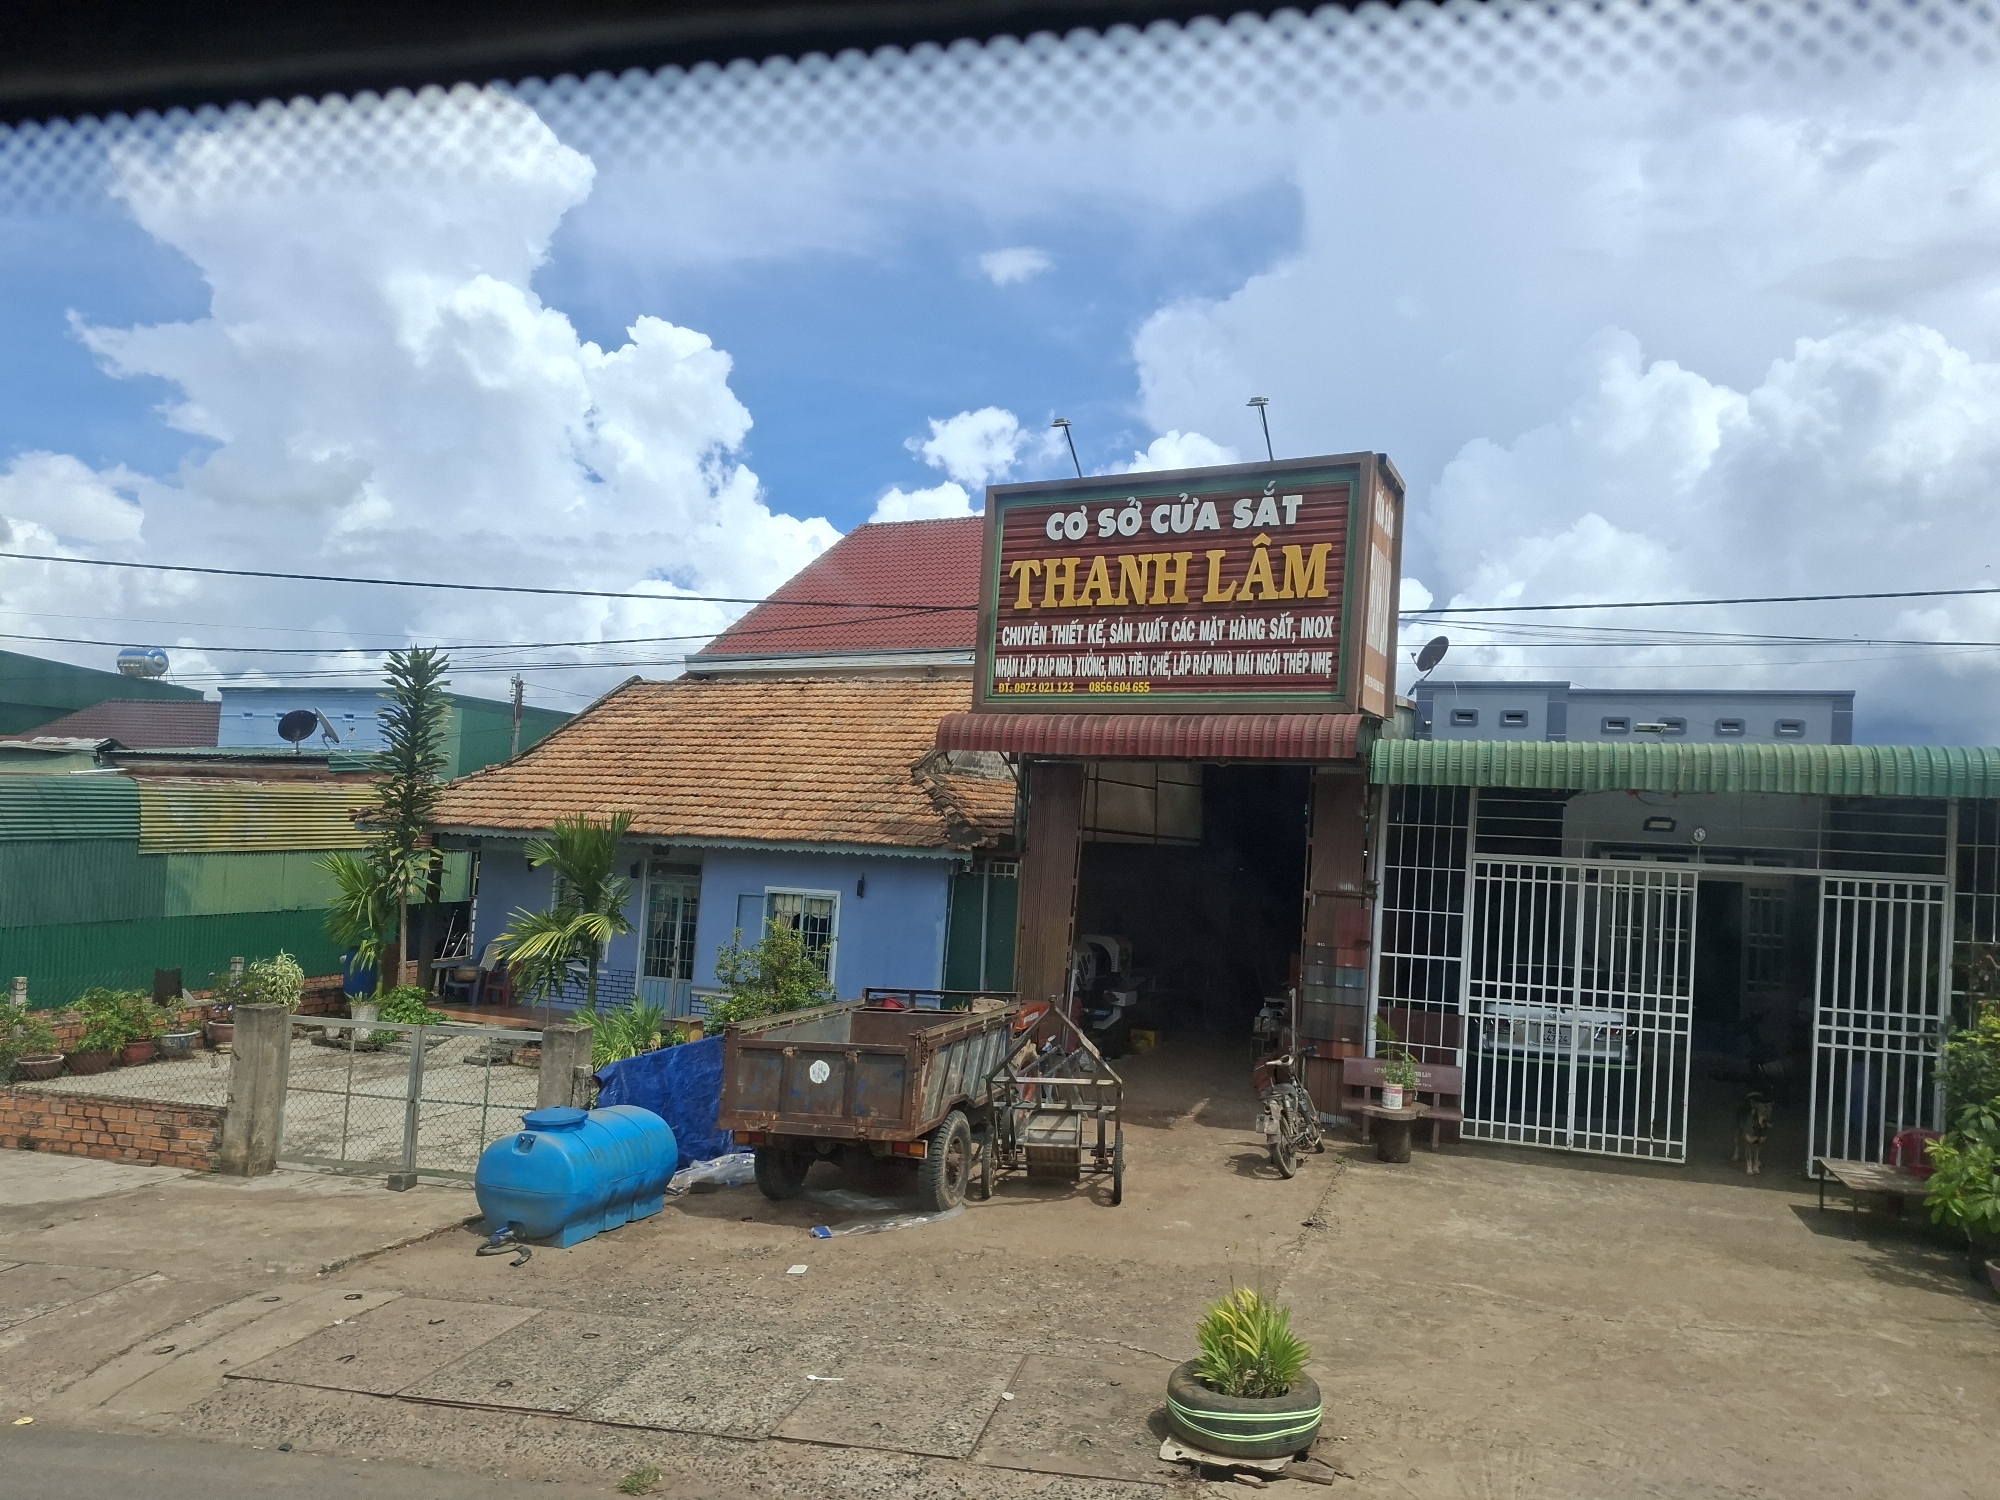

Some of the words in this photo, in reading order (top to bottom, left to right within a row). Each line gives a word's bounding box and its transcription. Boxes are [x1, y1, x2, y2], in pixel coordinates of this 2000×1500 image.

[1046, 505, 1089, 541] CƠ
[1097, 497, 1143, 538] SỞ
[1150, 492, 1221, 534] CỬA
[1232, 480, 1303, 529] SẮT
[1009, 551, 1193, 610] THANH
[1202, 532, 1333, 603] LÂM
[1001, 621, 1047, 647] CHUYÊN
[1051, 618, 1085, 645] THIẾT
[1087, 617, 1107, 648] KẾ,
[1109, 616, 1133, 644] SẢN
[1136, 615, 1169, 643] XUẤT
[1171, 616, 1196, 642] CÁC
[1199, 615, 1226, 646] MẶT
[1229, 614, 1266, 641] HÀNG
[1269, 611, 1296, 644] SẮT,
[1300, 615, 1335, 639] INOX
[995, 654, 1019, 682] NHẬN
[1020, 653, 1037, 678] LẮP
[1037, 654, 1056, 677] RÁP
[1055, 653, 1073, 677] NHÀ
[1107, 652, 1127, 677] NHÀ
[1172, 650, 1192, 676] LẮP
[1192, 650, 1213, 676] RÁP
[1212, 650, 1233, 675] NHÀ
[1235, 650, 1255, 675] MÁI
[1256, 649, 1281, 675] NGÓI
[1282, 648, 1310, 674] THÉP
[1310, 651, 1333, 679] NHẸ
[1057, 682, 1074, 693] 123
